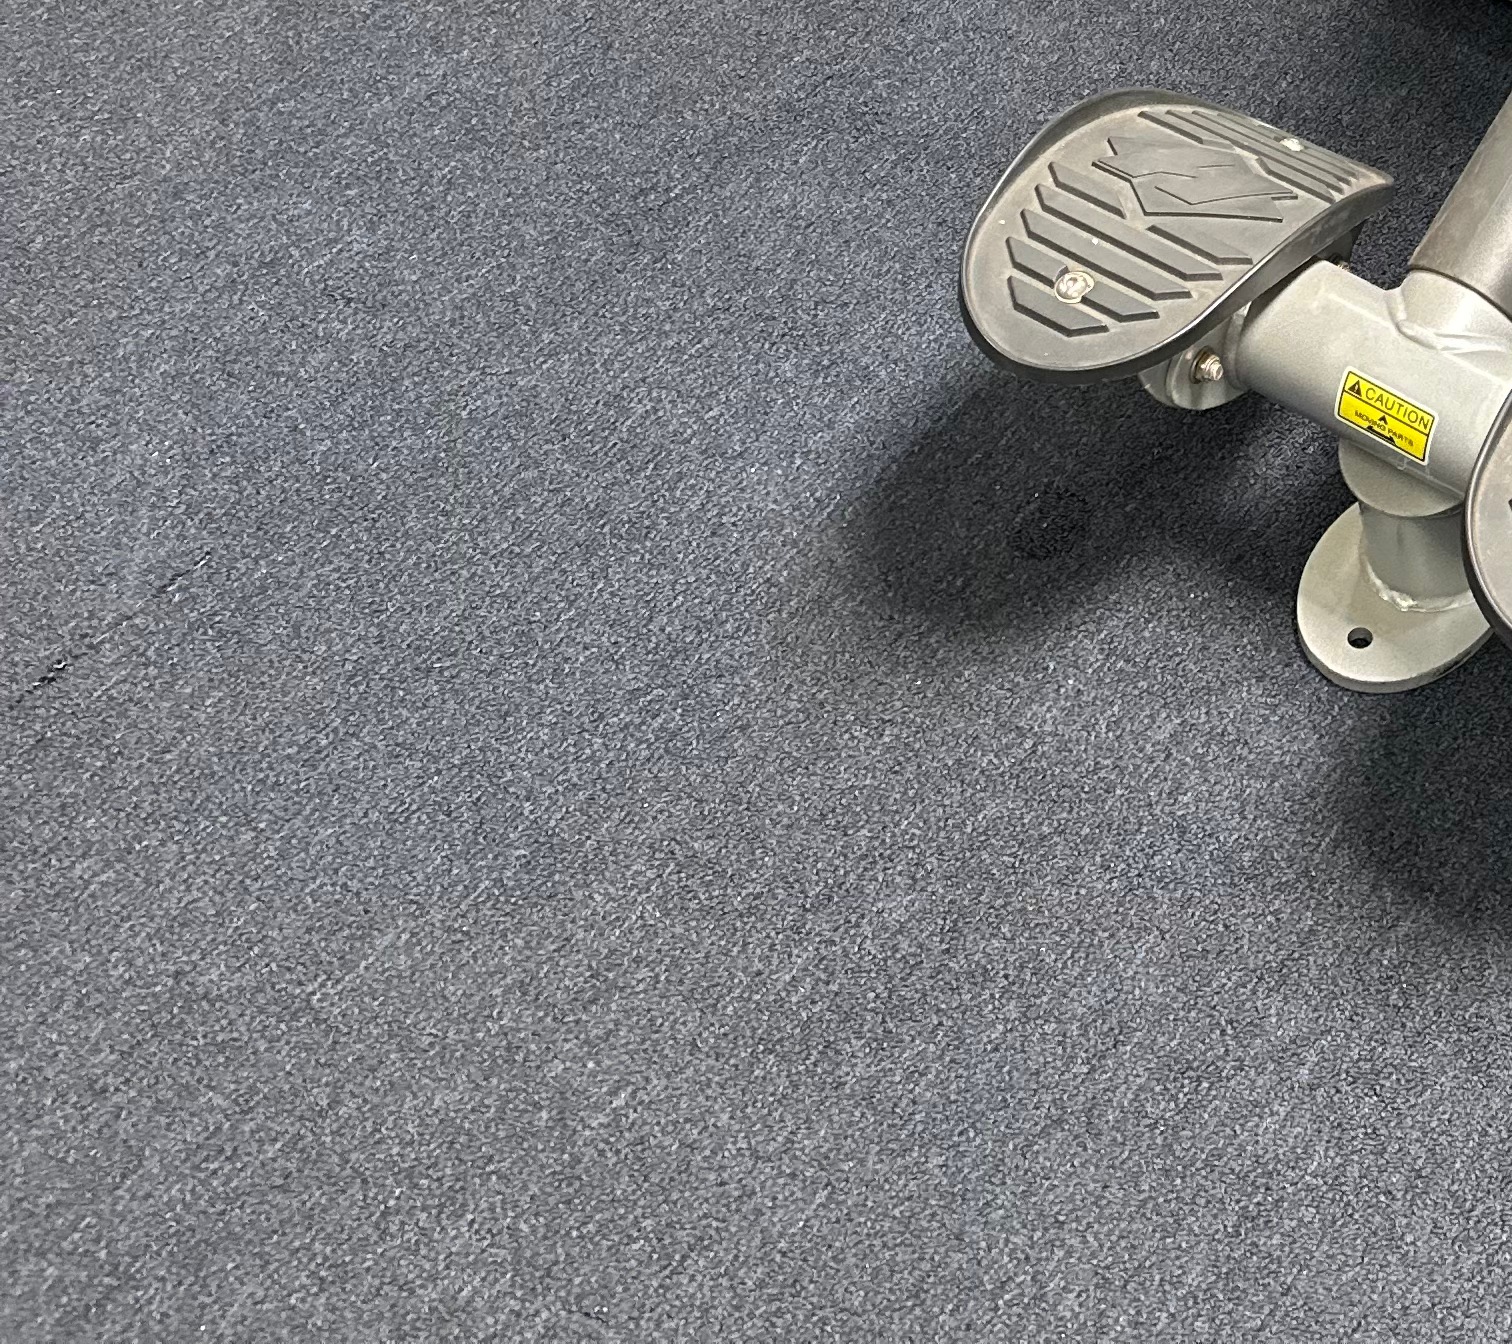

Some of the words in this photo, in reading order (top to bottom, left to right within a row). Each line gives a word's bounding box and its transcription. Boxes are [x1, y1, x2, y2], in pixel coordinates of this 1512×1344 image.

[1354, 409, 1387, 432] MOVING
[1387, 427, 1414, 447] PARTS
[1365, 387, 1430, 431] CAUTION
